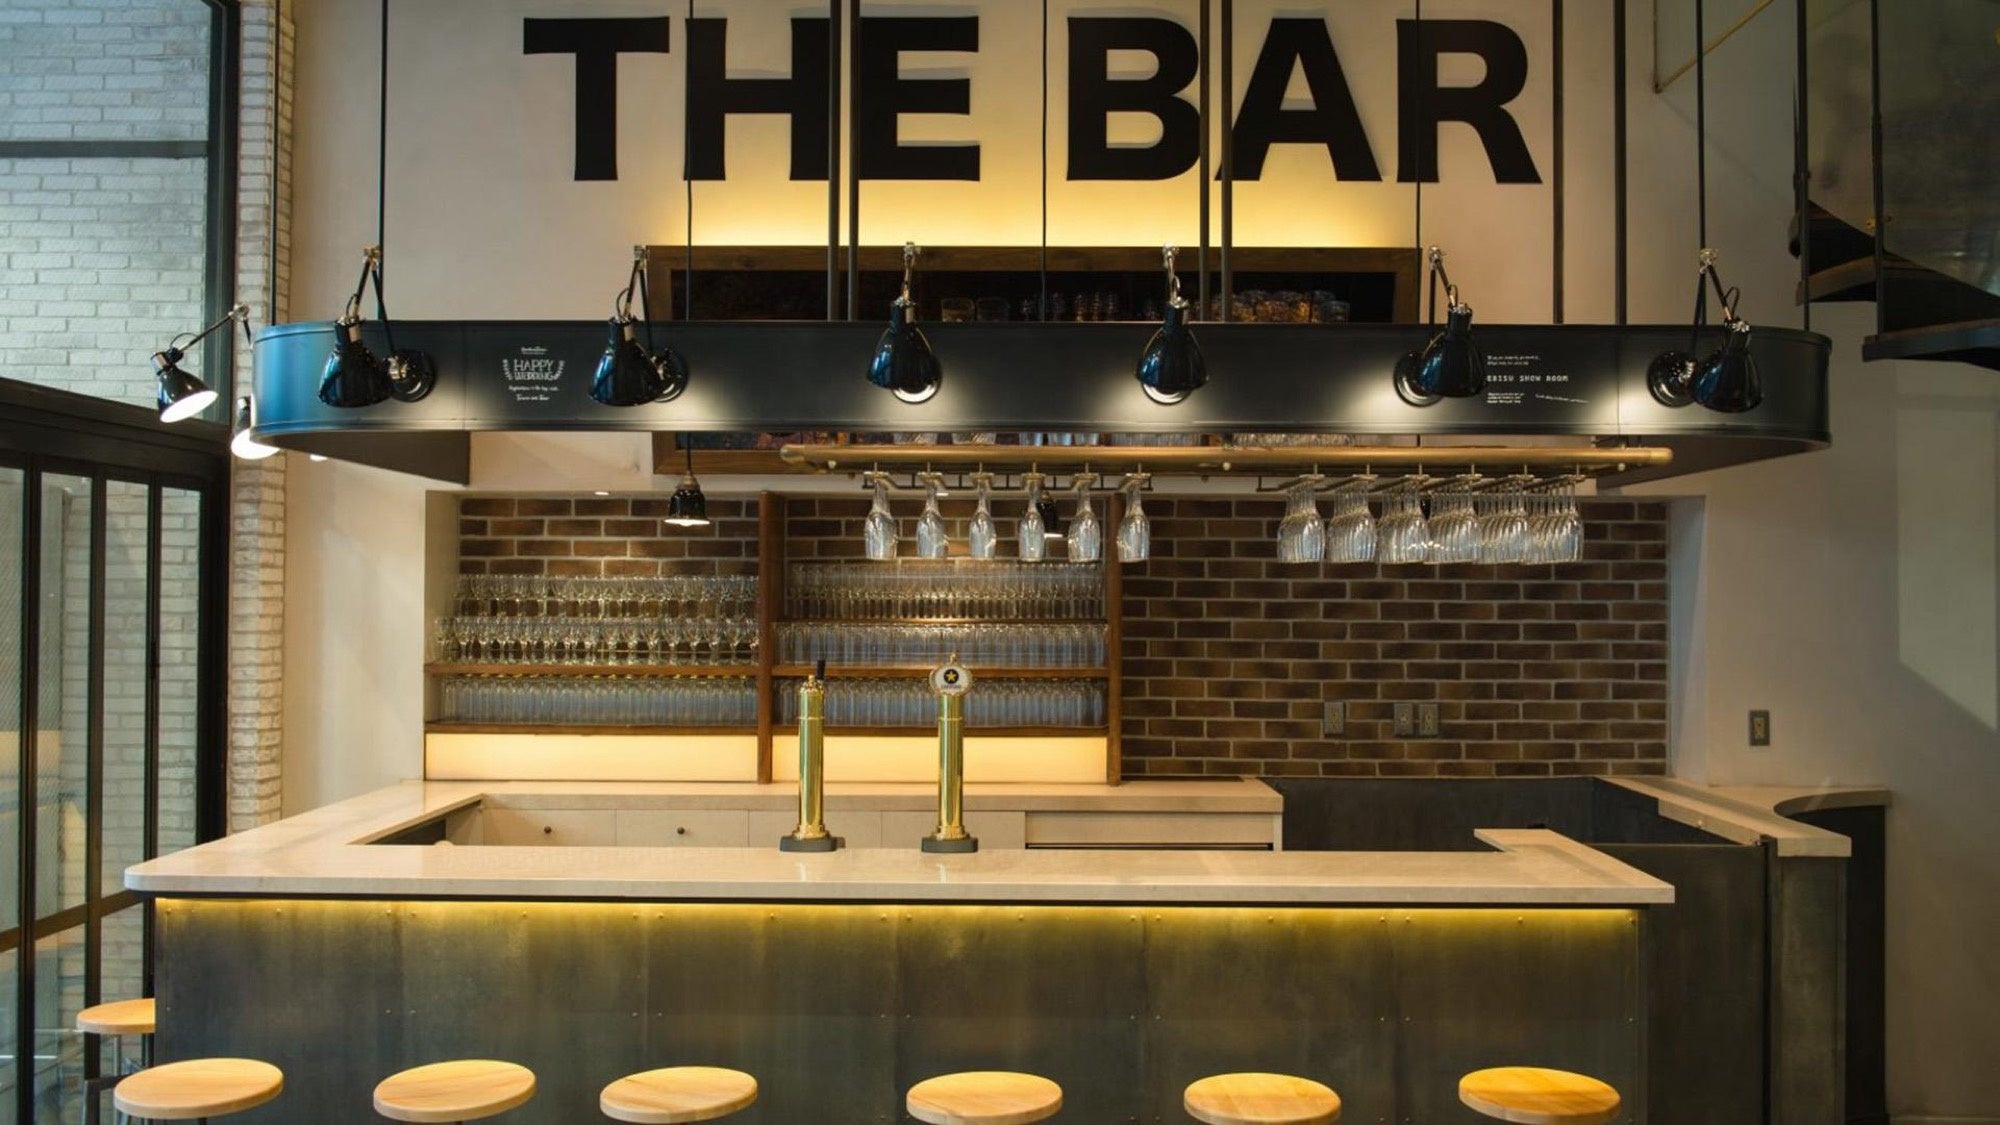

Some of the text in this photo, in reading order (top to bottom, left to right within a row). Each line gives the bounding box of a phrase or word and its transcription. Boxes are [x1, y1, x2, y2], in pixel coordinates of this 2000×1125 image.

[523, 17, 1543, 183] THE BAR
[513, 359, 554, 372] HAPPY
[513, 371, 555, 381] WEDDING
